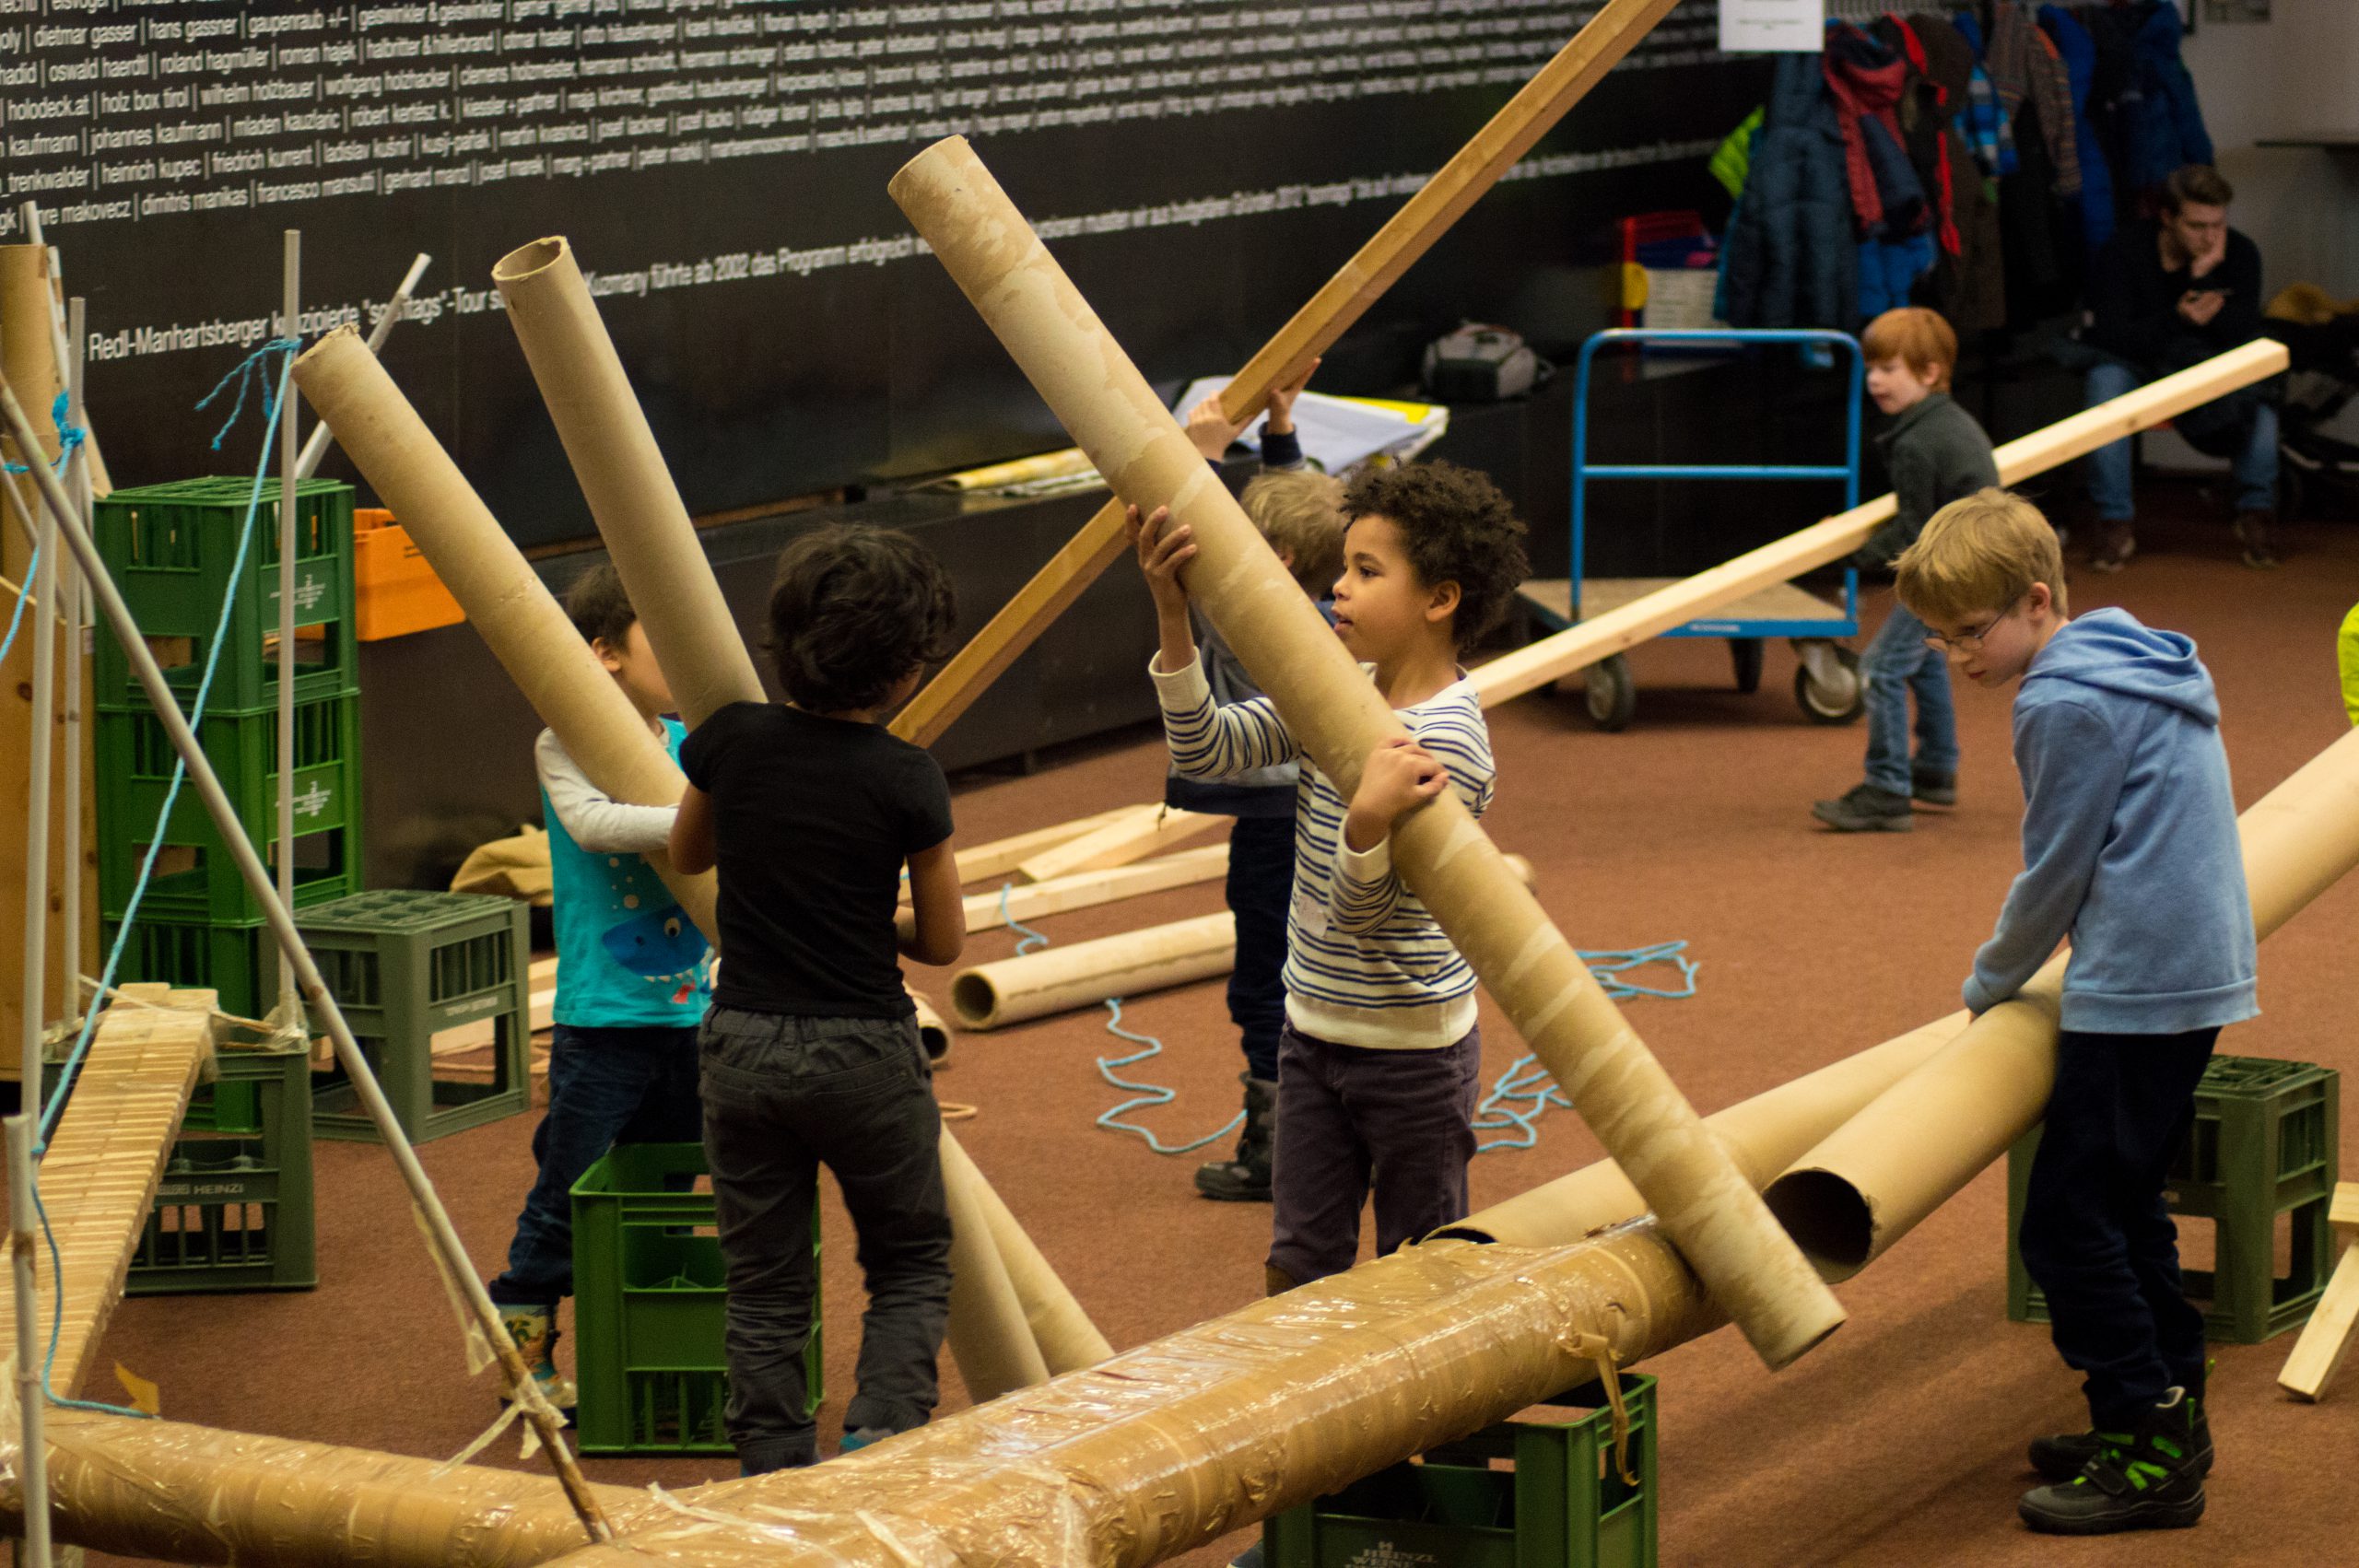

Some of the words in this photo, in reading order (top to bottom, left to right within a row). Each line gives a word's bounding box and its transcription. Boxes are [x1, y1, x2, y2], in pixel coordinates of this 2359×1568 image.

[33, 25, 88, 48] dietmar
[90, 24, 137, 50] gasser
[148, 18, 182, 40] hans
[184, 18, 238, 43] gassner
[48, 57, 100, 83] oswald
[159, 50, 204, 74] roland
[205, 46, 270, 76] hagmüller
[278, 46, 321, 65] roman
[7, 94, 90, 121] holodeck.at
[100, 90, 131, 113] holz
[133, 89, 160, 111] box
[162, 86, 190, 109] tirol
[200, 82, 250, 105] wilhelm
[252, 78, 315, 101] holzbauer
[8, 132, 78, 157] kaufmann
[90, 127, 153, 156] johannes
[156, 120, 222, 144] kaufmann
[350, 105, 390, 127] robert
[101, 158, 156, 183] heinrich
[158, 158, 202, 182] kupec
[211, 148, 265, 173] friedrich
[267, 145, 313, 169] kurrent
[61, 200, 132, 224] makovecz
[140, 190, 192, 216] dimitris
[193, 185, 249, 210] manikas
[257, 181, 321, 203] francesco
[88, 318, 268, 361] Redl-Manhartsberger
